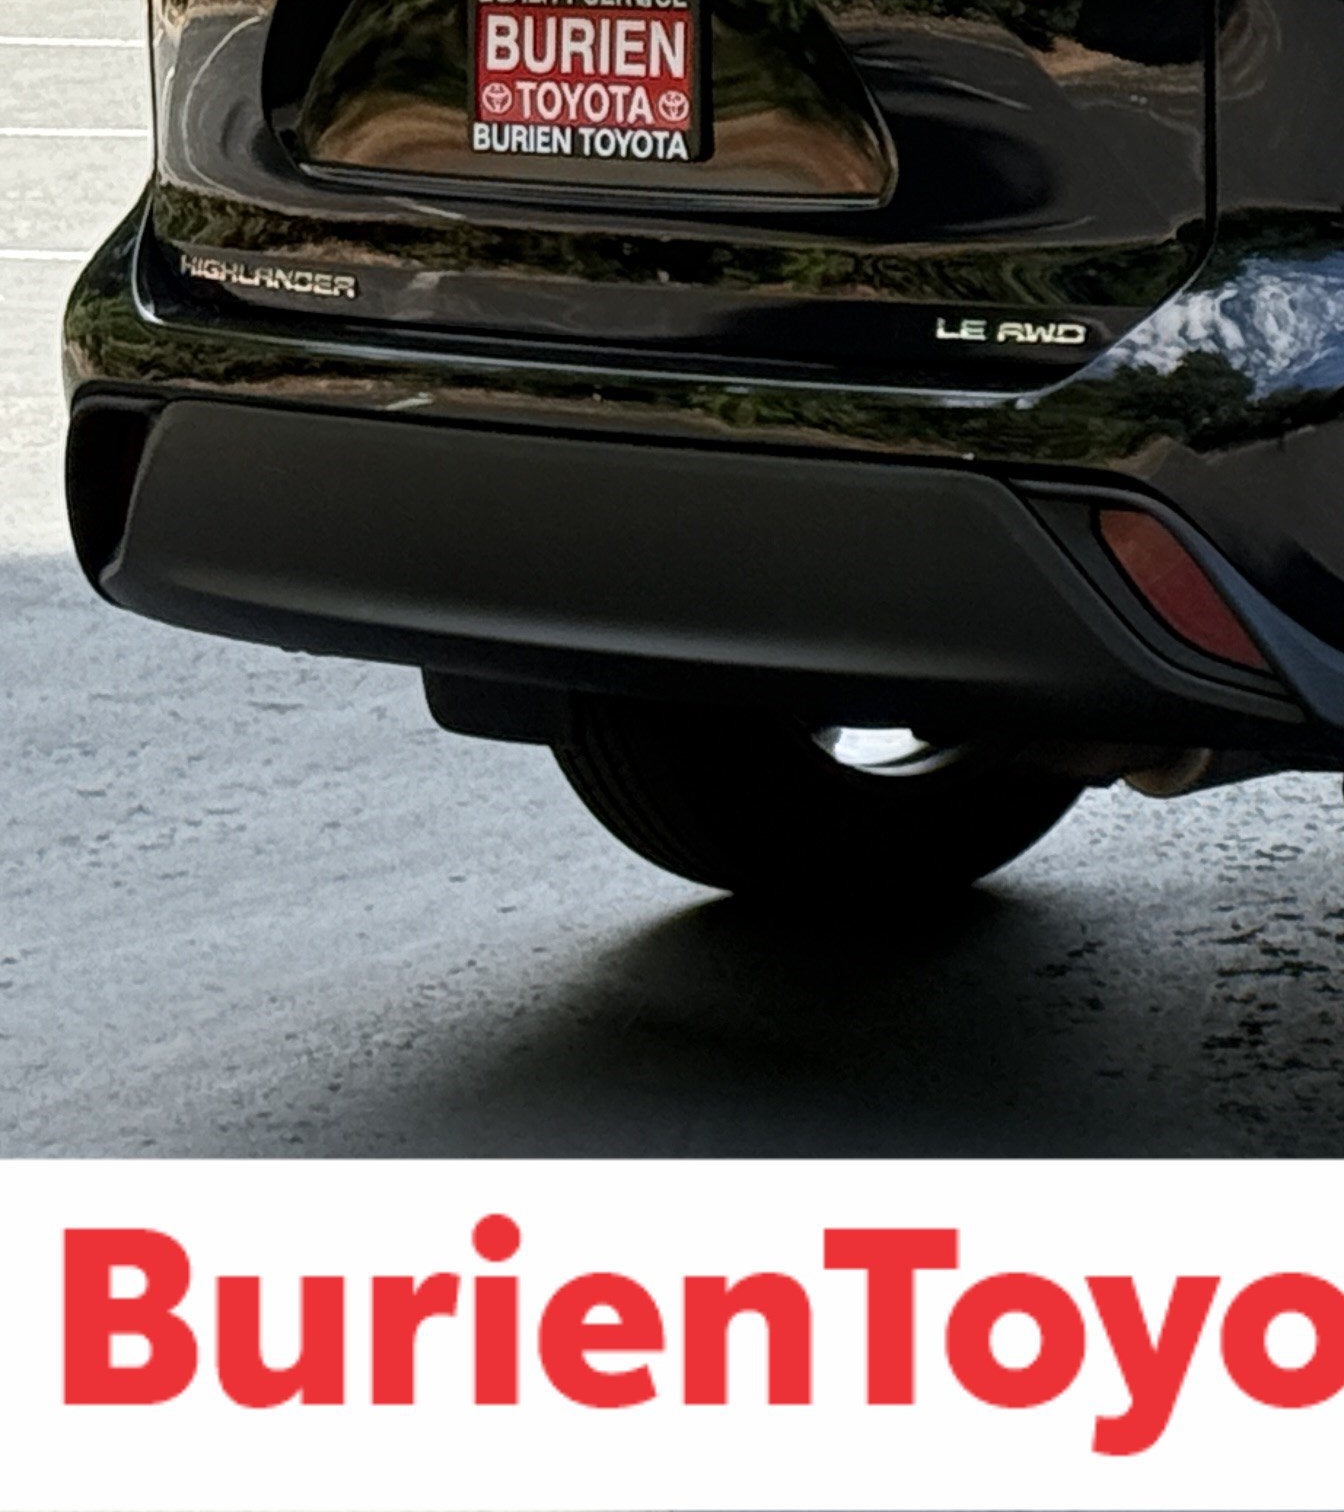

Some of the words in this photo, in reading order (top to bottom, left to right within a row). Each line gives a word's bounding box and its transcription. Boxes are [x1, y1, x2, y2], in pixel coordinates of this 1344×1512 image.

[485, 14, 687, 79] BURIEN
[515, 81, 656, 125] TOYOTA
[472, 122, 573, 155] BURIEN
[579, 129, 690, 161] TOYOTA
[179, 254, 357, 299] HIGHLANDER
[935, 316, 988, 341] LE
[996, 321, 1088, 345] AWD
